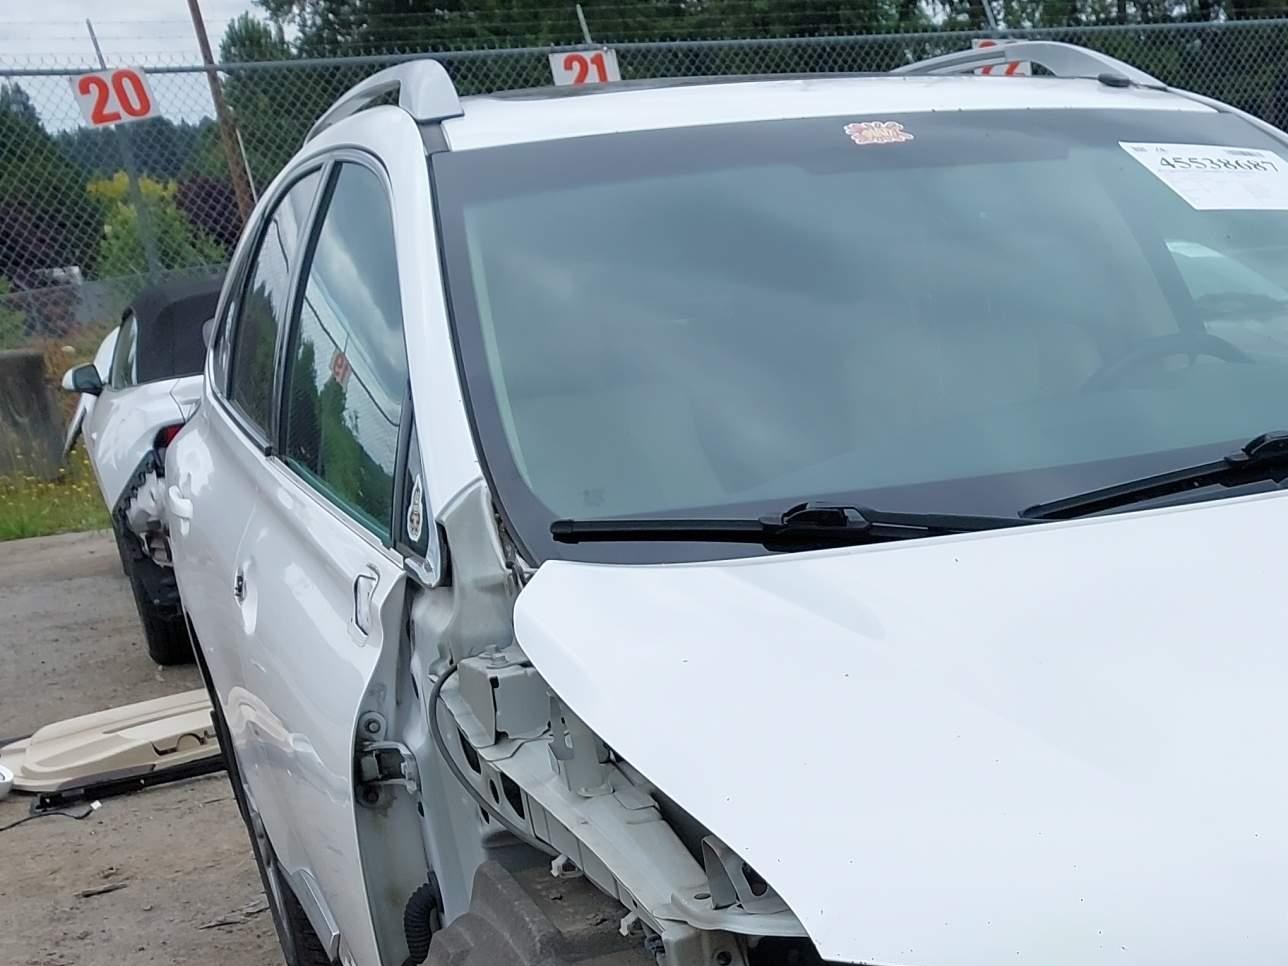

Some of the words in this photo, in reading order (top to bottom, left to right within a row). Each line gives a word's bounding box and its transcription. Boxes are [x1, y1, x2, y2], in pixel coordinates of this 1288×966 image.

[564, 52, 609, 84] 21
[78, 69, 151, 125] 20
[1160, 156, 1279, 172] 45538687
